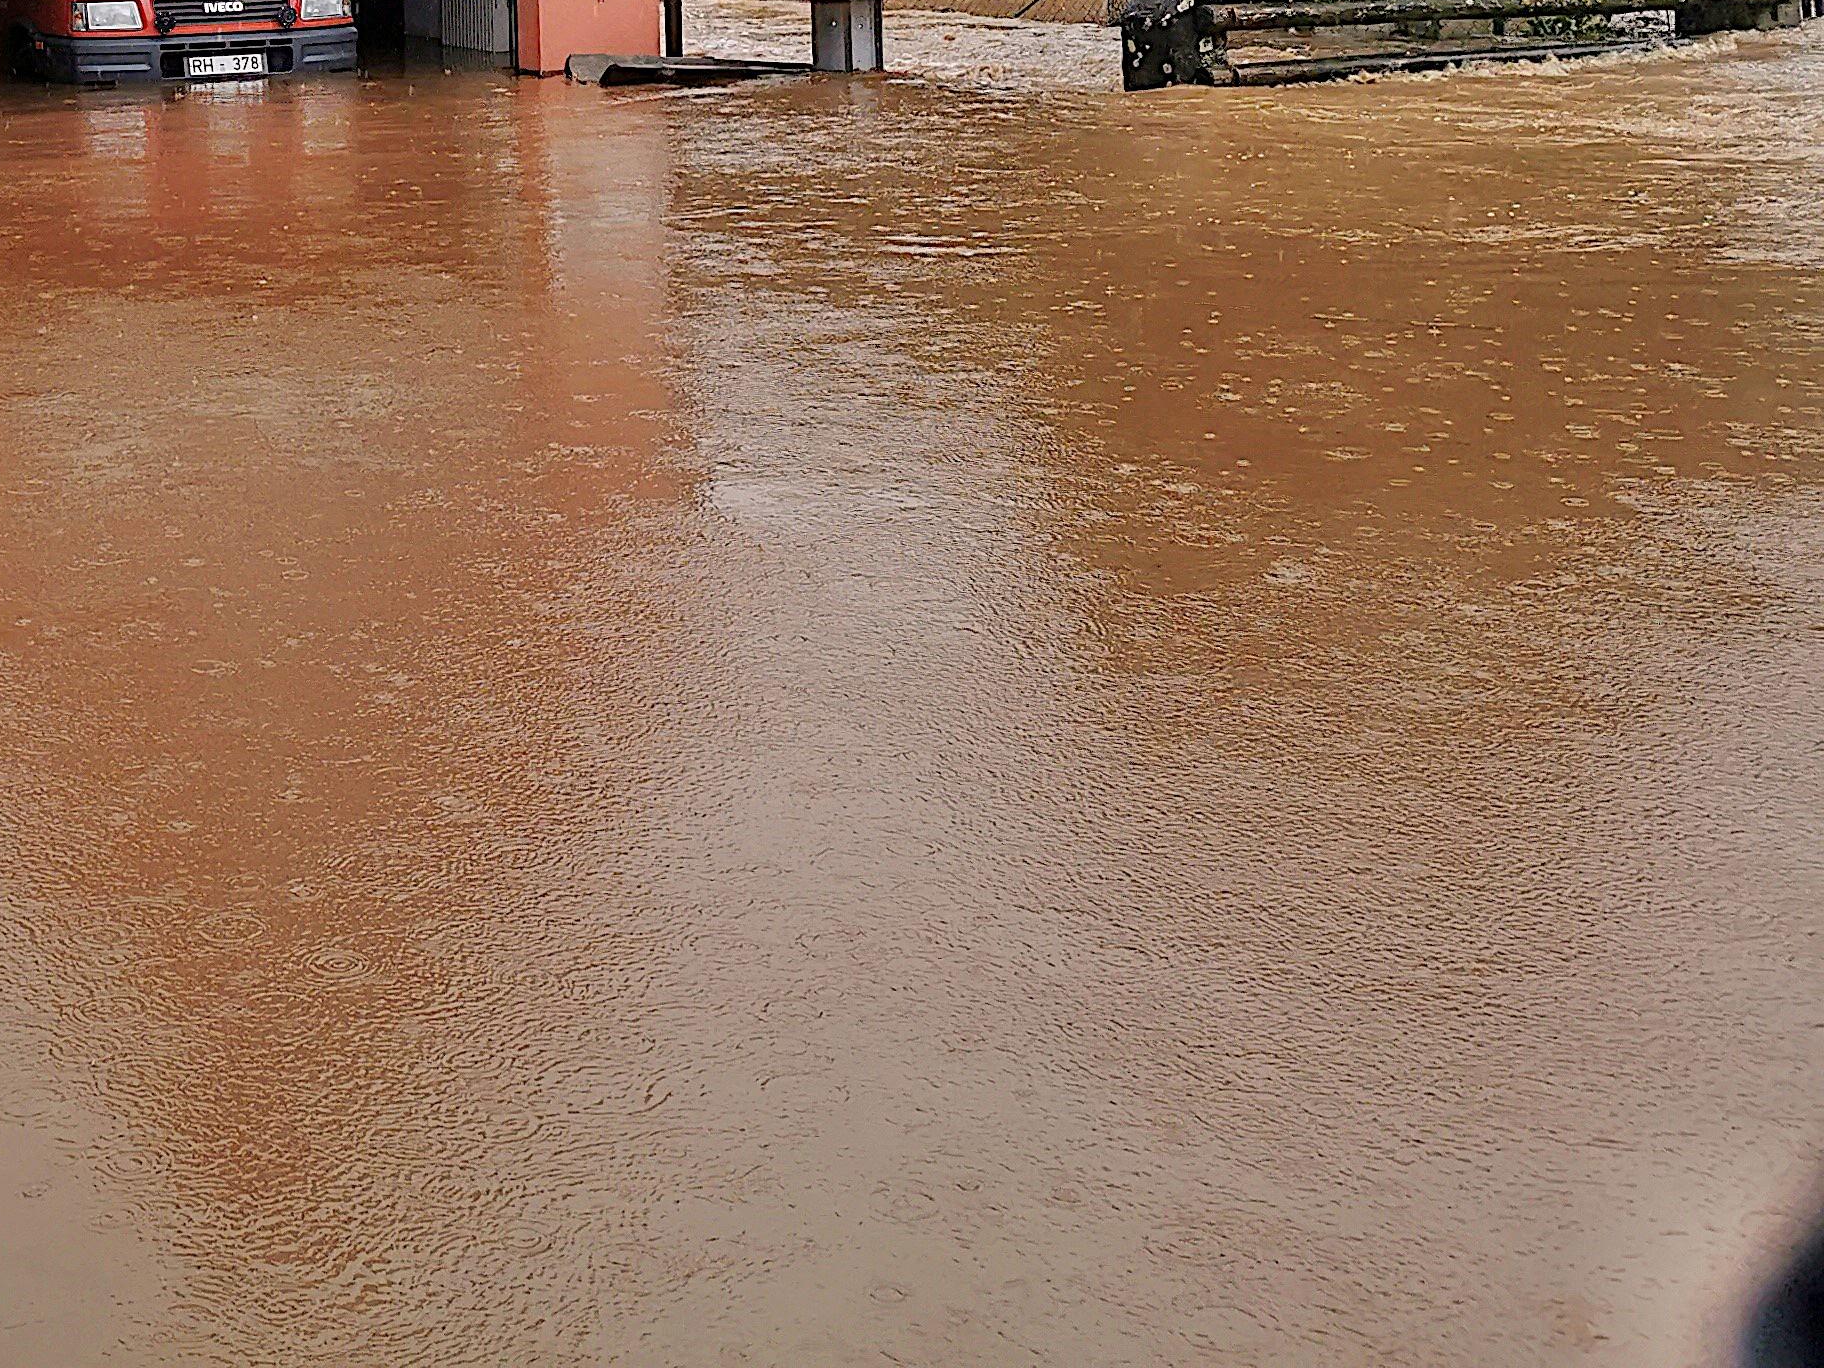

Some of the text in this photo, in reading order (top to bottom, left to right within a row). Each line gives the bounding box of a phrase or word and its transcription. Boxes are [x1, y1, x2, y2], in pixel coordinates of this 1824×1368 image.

[203, 1, 244, 14] IVECO
[192, 58, 214, 73] RH
[232, 56, 259, 71] 378
